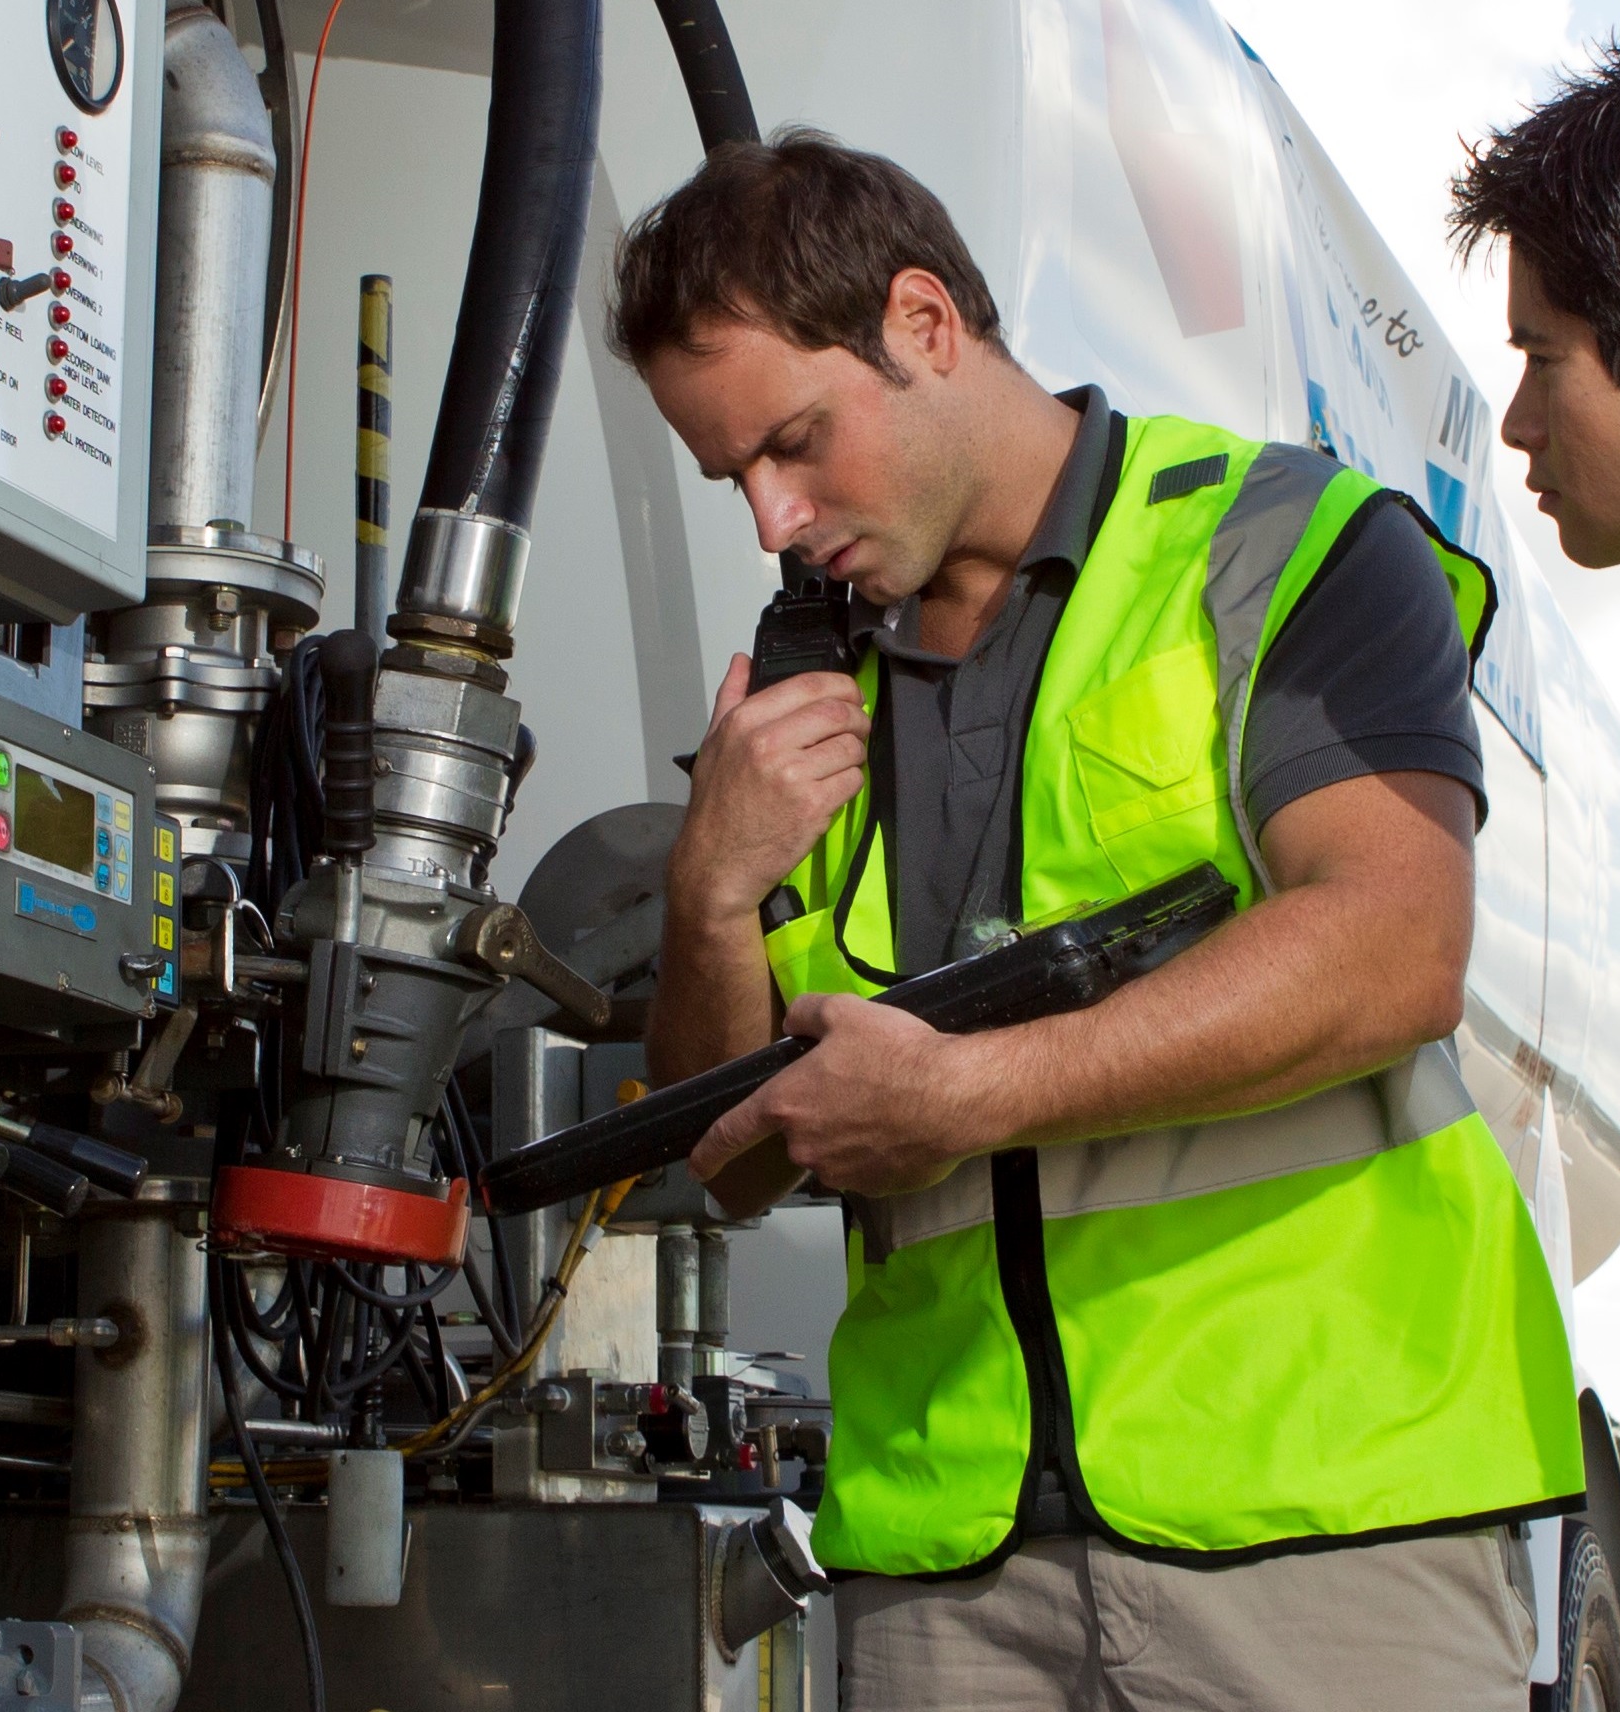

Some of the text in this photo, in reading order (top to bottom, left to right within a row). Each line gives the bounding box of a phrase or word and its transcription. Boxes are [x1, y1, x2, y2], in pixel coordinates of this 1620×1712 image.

[86, 154, 104, 176] LEVEL
[99, 270, 103, 281] 1
[98, 304, 103, 317] 2
[5, 321, 24, 342] REEL
[1383, 309, 1424, 358] to
[90, 335, 116, 361] LOADING
[9, 375, 19, 392] ON
[96, 368, 112, 387] TANK
[61, 393, 116, 433] WATER DETECTION
[0, 428, 18, 448] ERROR
[75, 436, 112, 467] PROTECTION
[165, 845, 170, 858] 3
[164, 889, 170, 902] 6
[164, 932, 169, 945] 9
